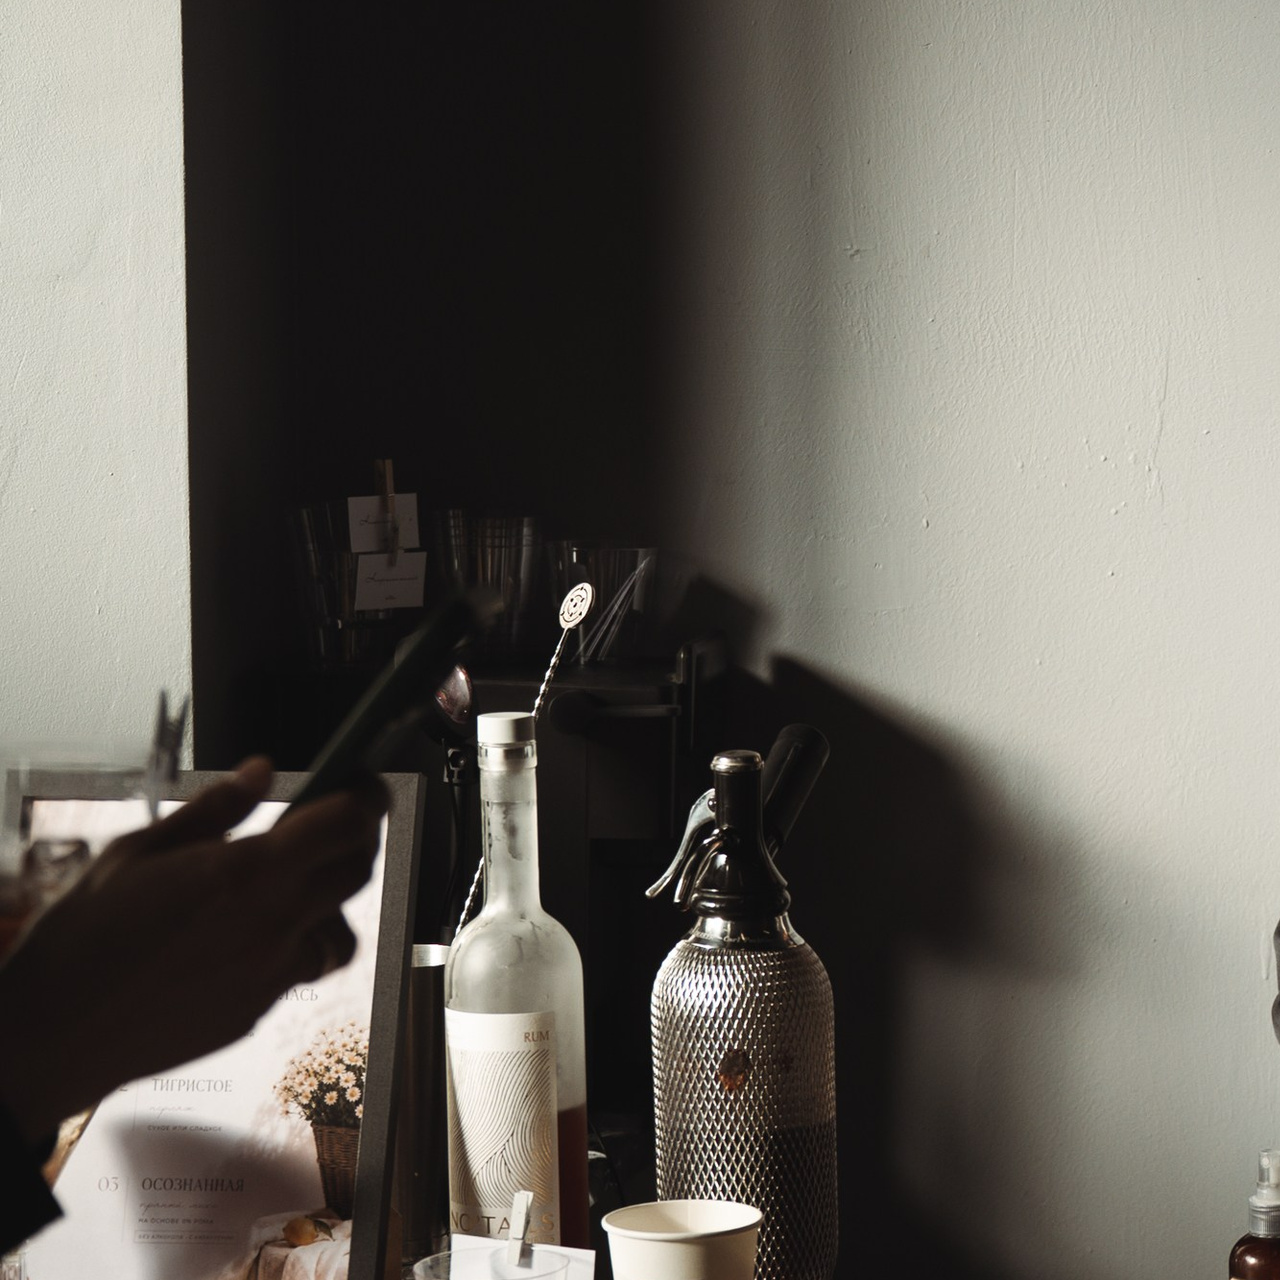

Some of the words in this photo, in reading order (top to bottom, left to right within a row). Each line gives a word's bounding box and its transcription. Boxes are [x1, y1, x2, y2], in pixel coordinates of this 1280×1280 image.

[524, 1031, 550, 1044] RUM
[151, 1078, 233, 1093] ТИГРИСТОЕ
[142, 1177, 246, 1193] ОСОЗНАННАЯ
